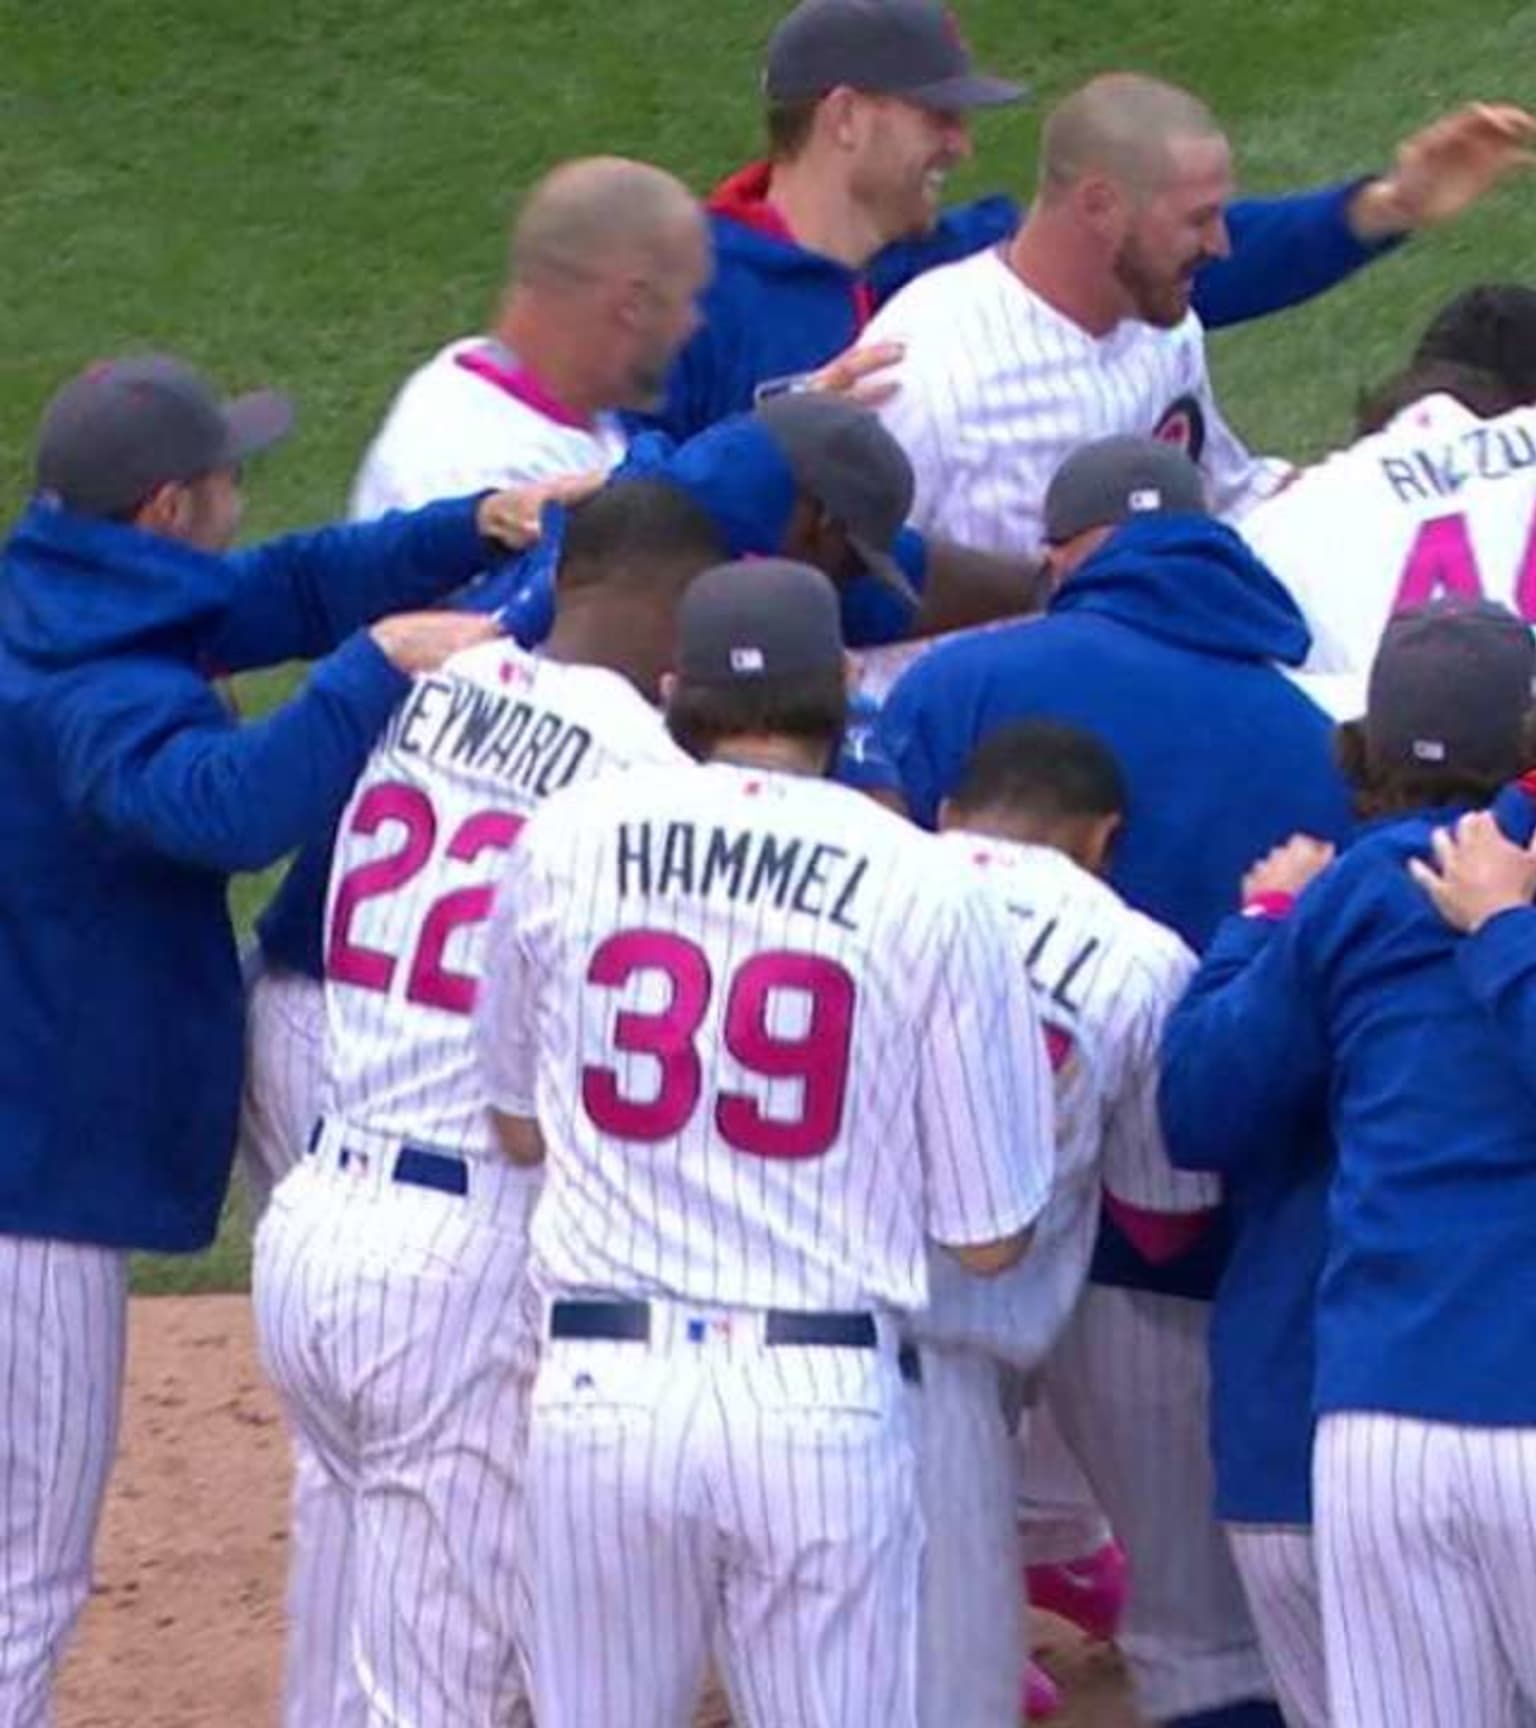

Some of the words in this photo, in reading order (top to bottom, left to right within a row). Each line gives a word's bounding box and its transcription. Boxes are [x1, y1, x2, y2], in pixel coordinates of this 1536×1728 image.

[385, 678, 592, 798] EYWARD
[326, 781, 526, 1016] 22
[616, 822, 869, 930] HAMMEL
[581, 928, 857, 1160] 39
